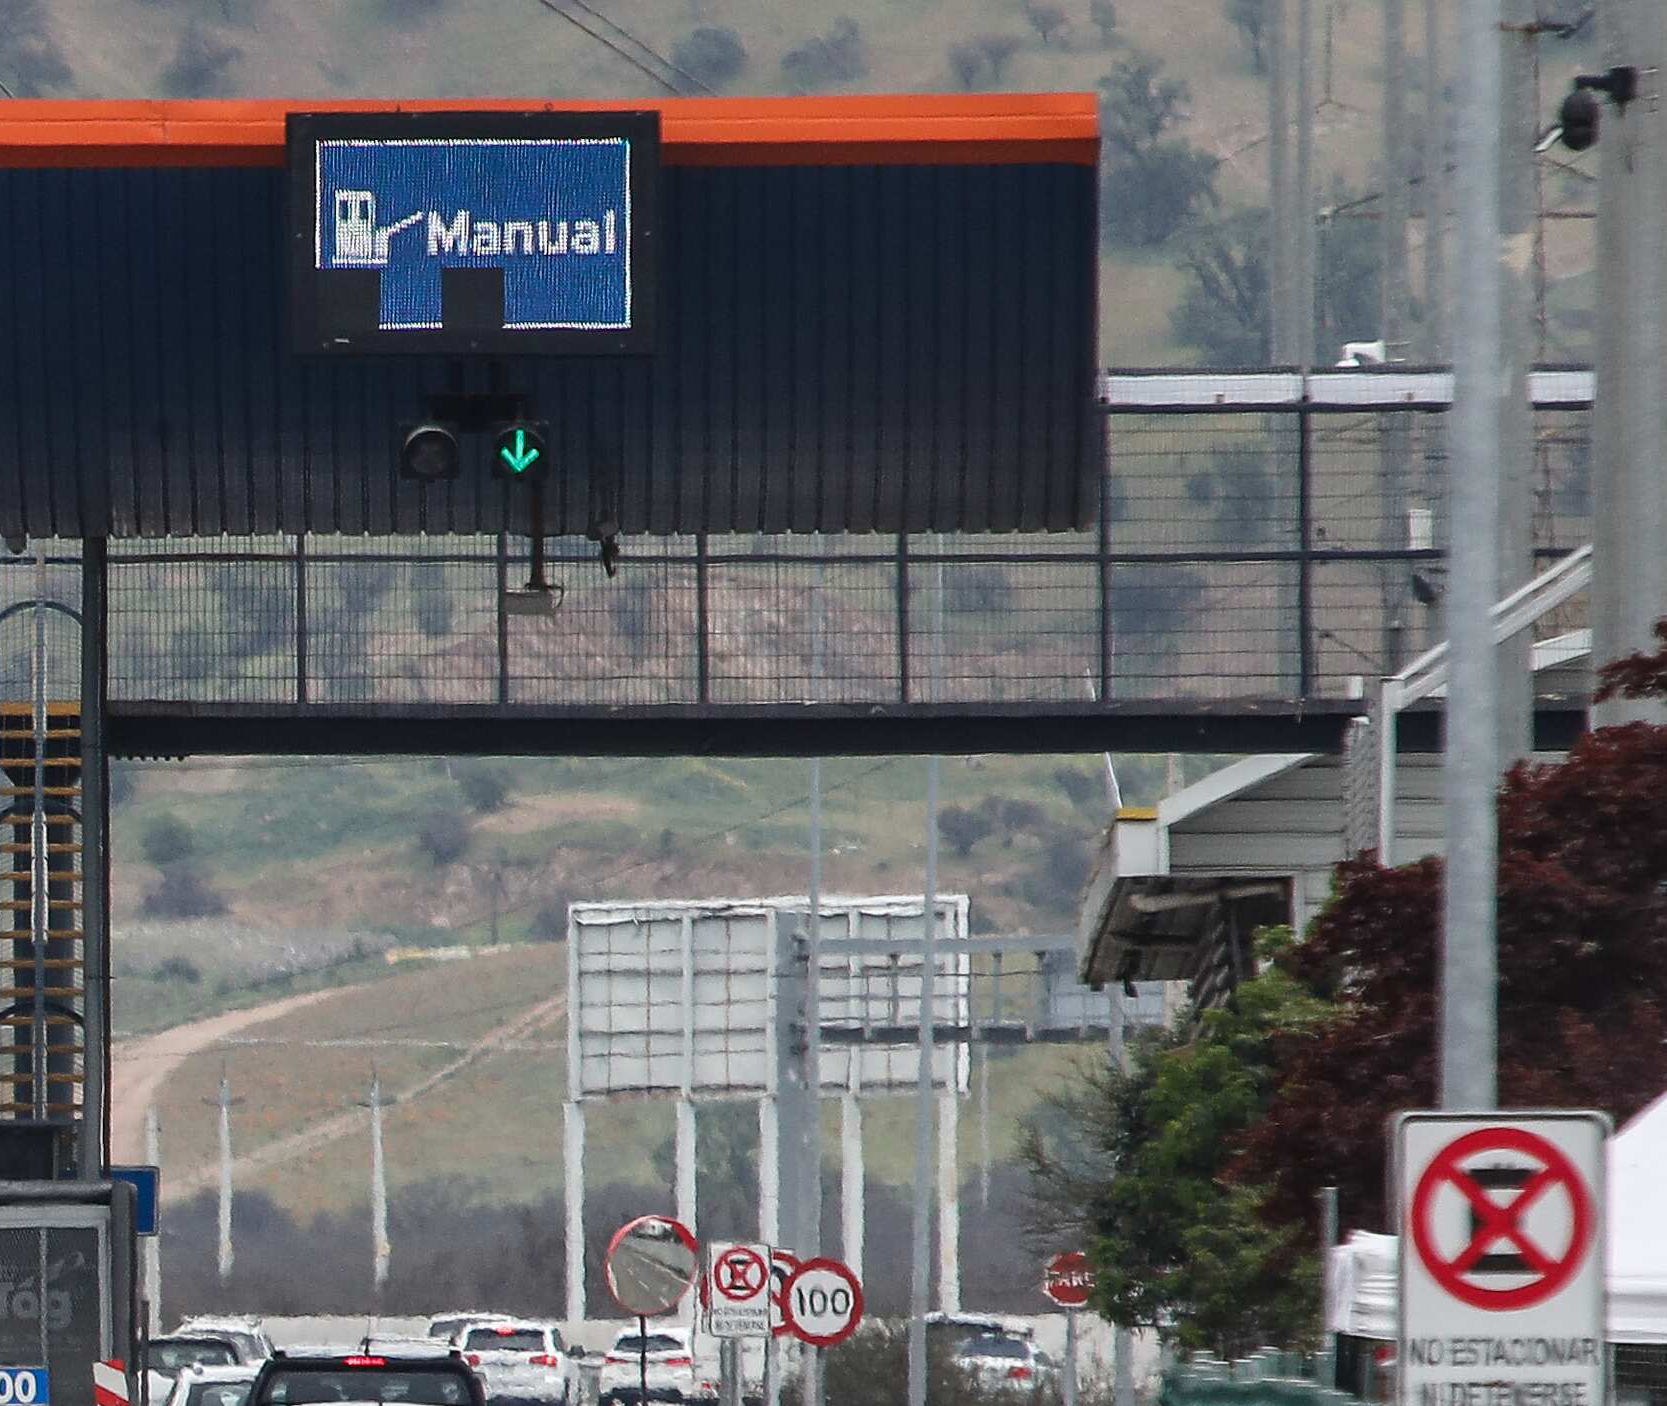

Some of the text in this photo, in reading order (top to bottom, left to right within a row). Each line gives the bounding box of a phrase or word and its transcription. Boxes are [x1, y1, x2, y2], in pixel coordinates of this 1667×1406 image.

[426, 209, 616, 256] Manual
[796, 1287, 850, 1318] 100
[1408, 1338, 1599, 1366] NO ESTACIONAR
